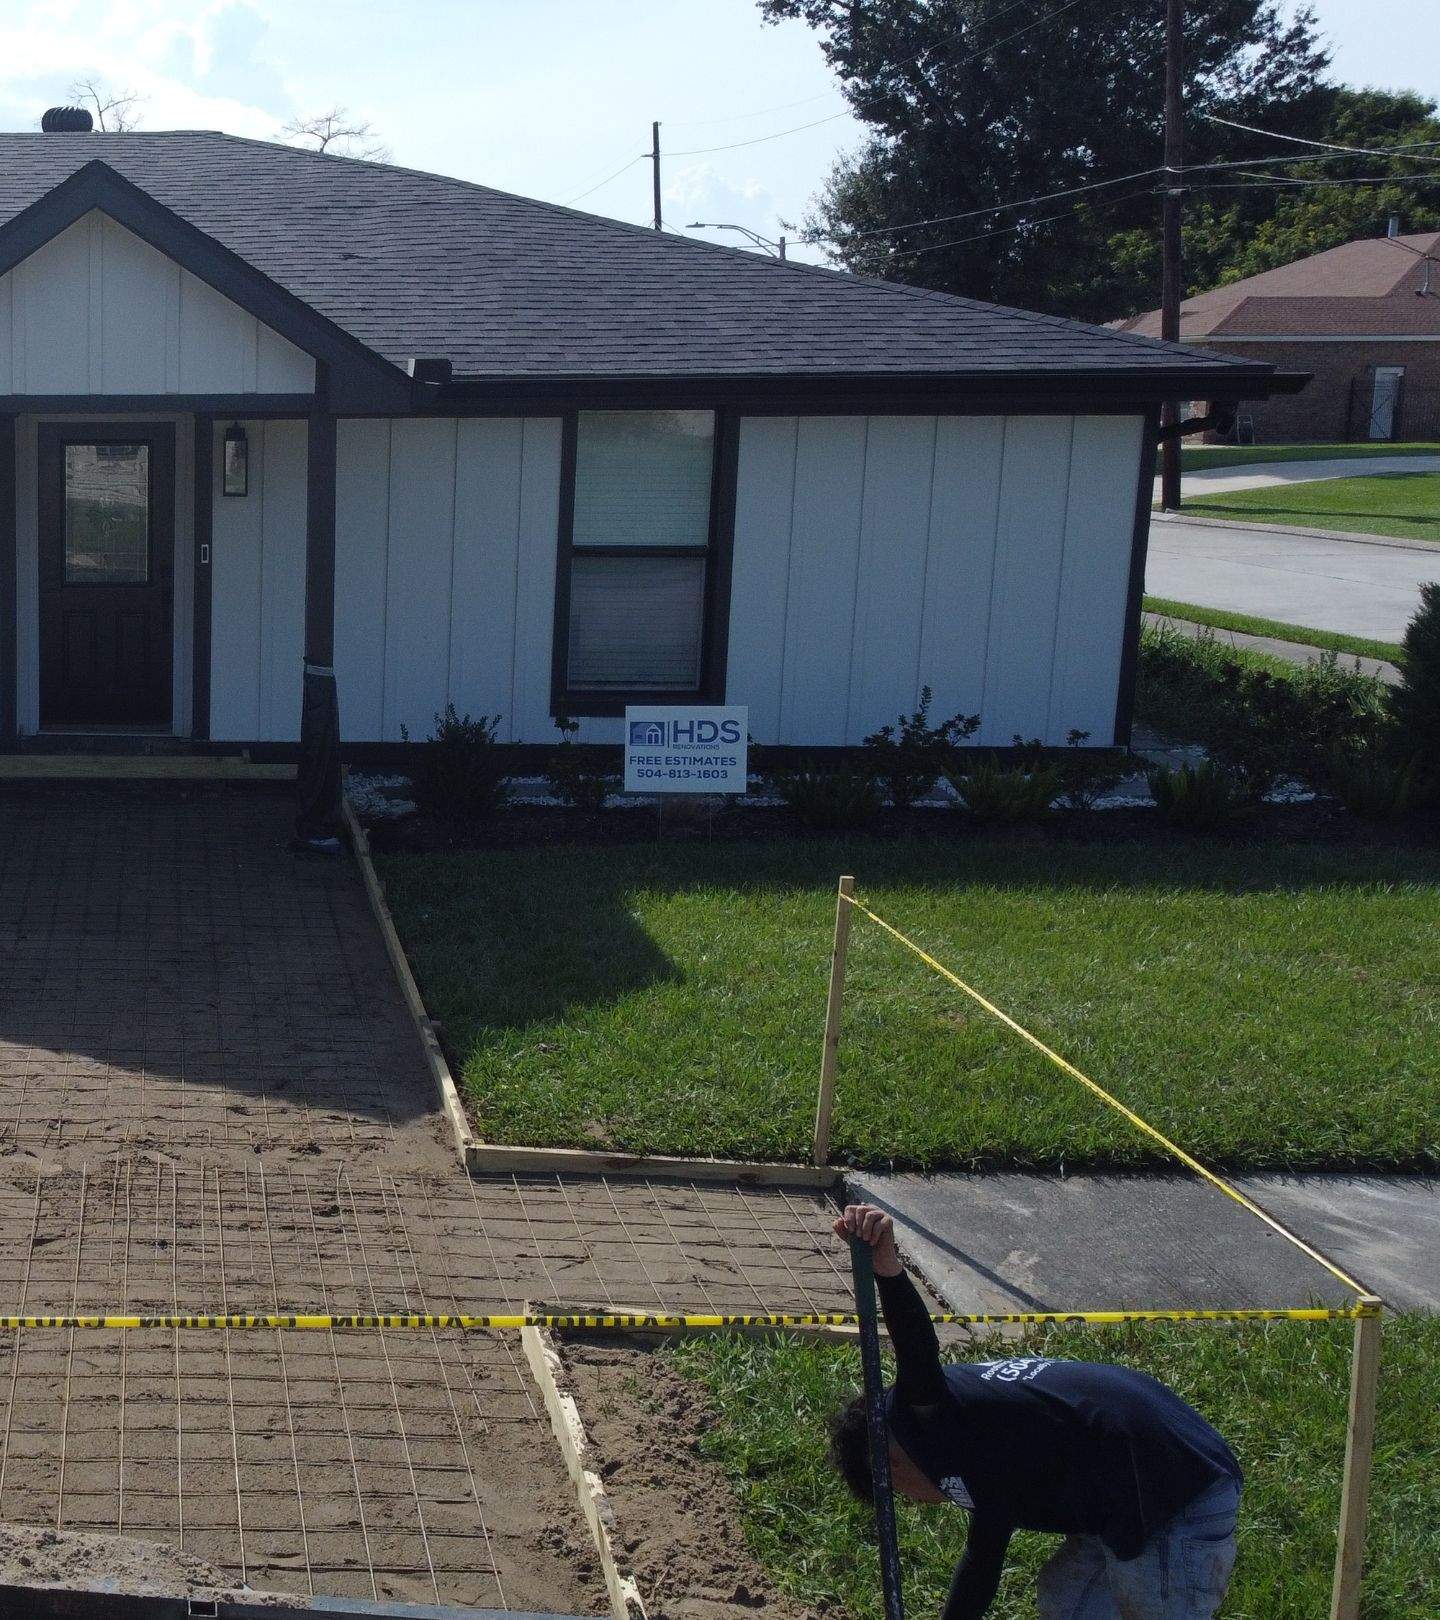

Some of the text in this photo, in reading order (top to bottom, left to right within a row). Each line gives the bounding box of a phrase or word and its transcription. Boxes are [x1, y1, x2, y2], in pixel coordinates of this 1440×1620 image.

[673, 720, 740, 743] HDS
[629, 756, 737, 767] FREE ESTIMATES
[637, 769, 728, 779] 504-813-1603
